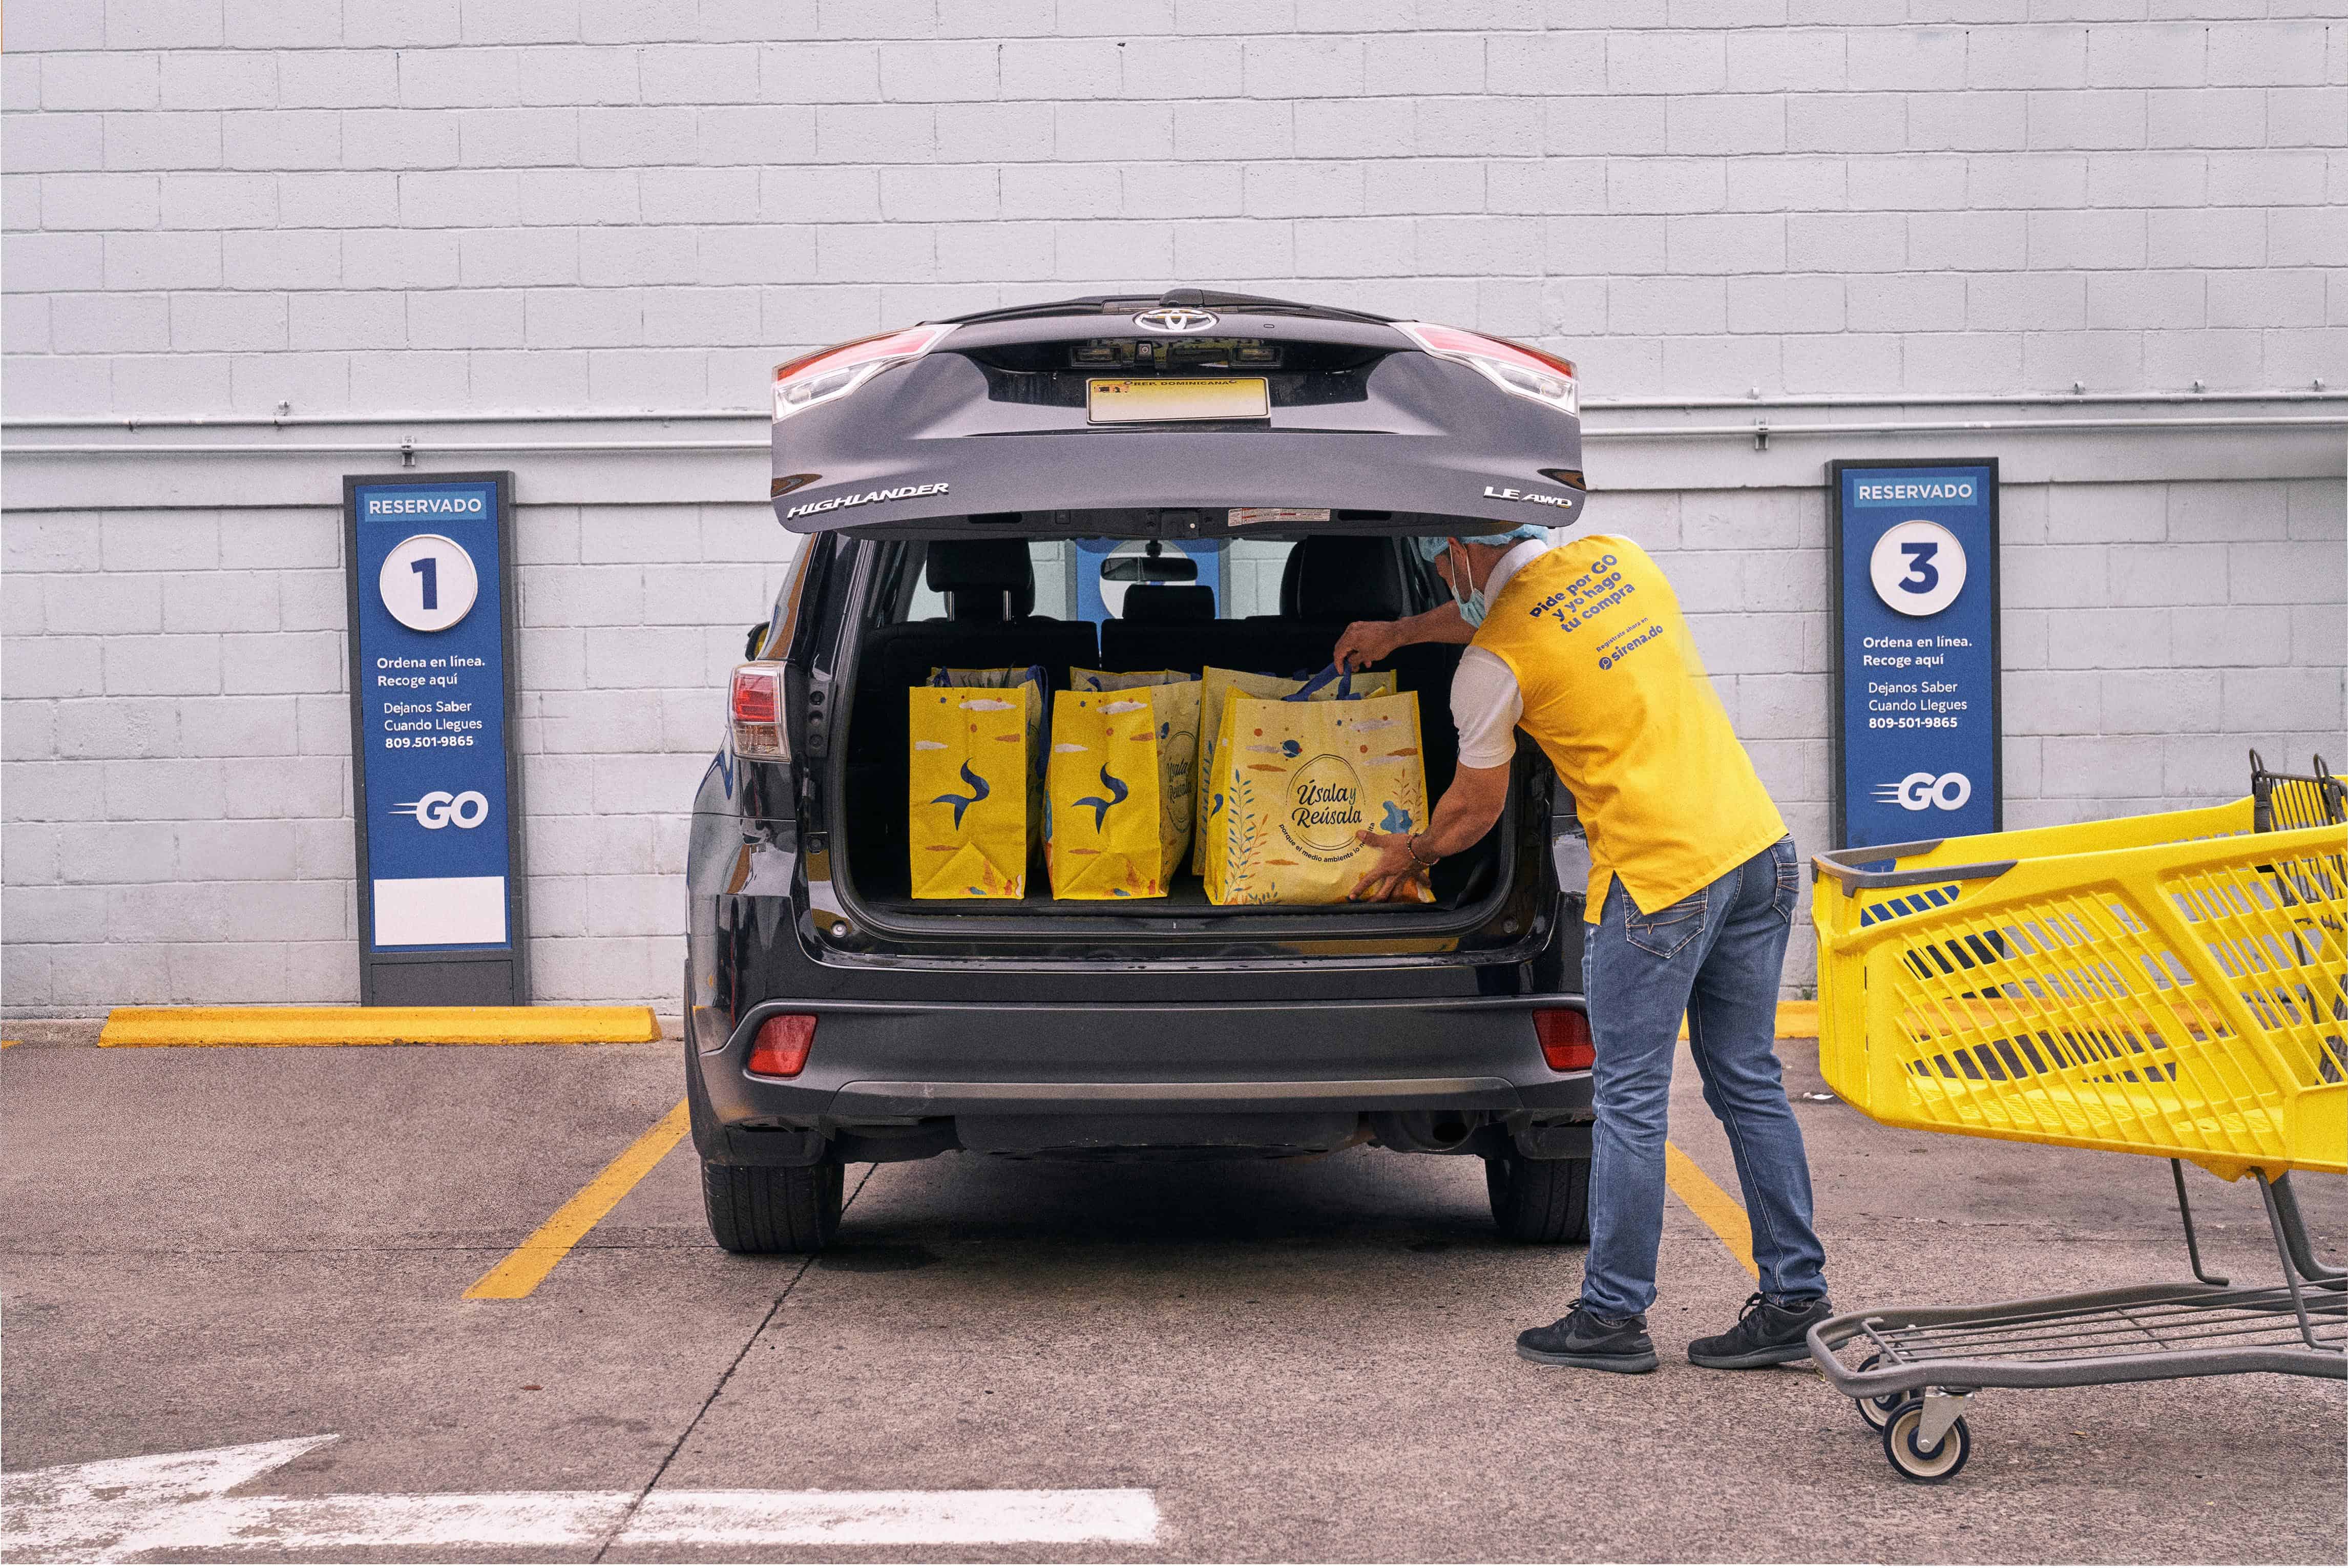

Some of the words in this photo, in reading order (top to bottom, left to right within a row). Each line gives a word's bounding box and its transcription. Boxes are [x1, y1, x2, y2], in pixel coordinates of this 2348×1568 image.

[787, 483, 949, 519] HIGHLANDER
[1483, 486, 1520, 501] LE
[1521, 494, 1573, 508] AWD
[1858, 484, 1973, 500] RESERVADO
[369, 498, 482, 514] RESERVADO
[1898, 542, 1939, 594] 3
[411, 557, 437, 610] 1
[1529, 592, 1566, 618] Pide
[1566, 574, 1592, 596] por
[1591, 554, 1618, 574] GO
[1552, 608, 1565, 622] y
[1564, 598, 1585, 613] yo
[1582, 572, 1622, 598] hago
[1561, 617, 1582, 633] tu
[1582, 583, 1636, 619] compra
[1626, 621, 1641, 633] ahora
[1611, 624, 1663, 661] sirena.do
[1863, 636, 1913, 648] Ordena
[1917, 638, 1933, 647] en
[1937, 635, 1973, 647] línea.
[376, 657, 427, 669] Ordena
[430, 659, 447, 668] en
[450, 655, 486, 667] línea.
[1863, 655, 1912, 668] Recoge
[1915, 653, 1944, 668] aquí
[378, 675, 426, 688] Recoge
[429, 673, 458, 688] aquí
[1869, 682, 1918, 696] Dejanos
[1921, 681, 1958, 693] Saber
[384, 702, 432, 716] Dejanos
[435, 701, 472, 712] Saber
[1869, 699, 1917, 711] Cuando
[1920, 699, 1967, 713] Llegues
[384, 718, 432, 731] Cuando
[435, 718, 483, 732] Llegues
[1869, 717, 1958, 728] 809-501-9865
[1297, 779, 1349, 806] Úsala
[1349, 787, 1356, 805] y
[1897, 772, 1972, 811] GO
[416, 790, 489, 829] GO
[1291, 805, 1362, 828] Reúsala
[1278, 824, 1296, 846] porque
[1302, 850, 1323, 862] medio
[1324, 852, 1354, 863] ambiente
